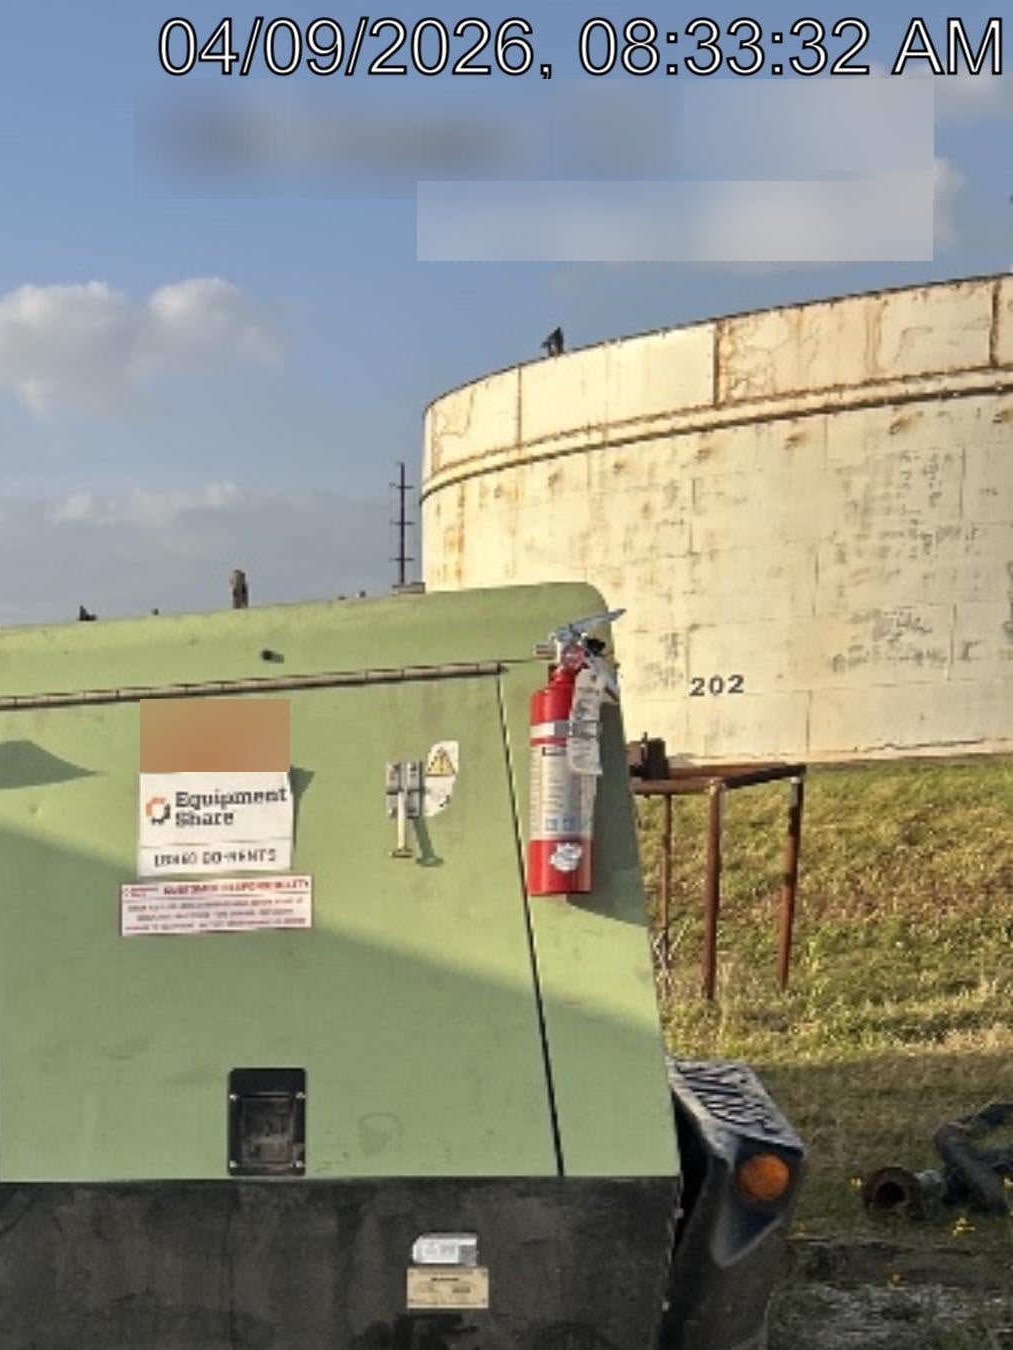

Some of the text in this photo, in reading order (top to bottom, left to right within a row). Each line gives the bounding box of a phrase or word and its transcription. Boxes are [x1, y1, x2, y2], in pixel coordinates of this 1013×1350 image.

[689, 674, 744, 697] 202
[175, 788, 287, 810] Equipment
[175, 811, 234, 828] Share
